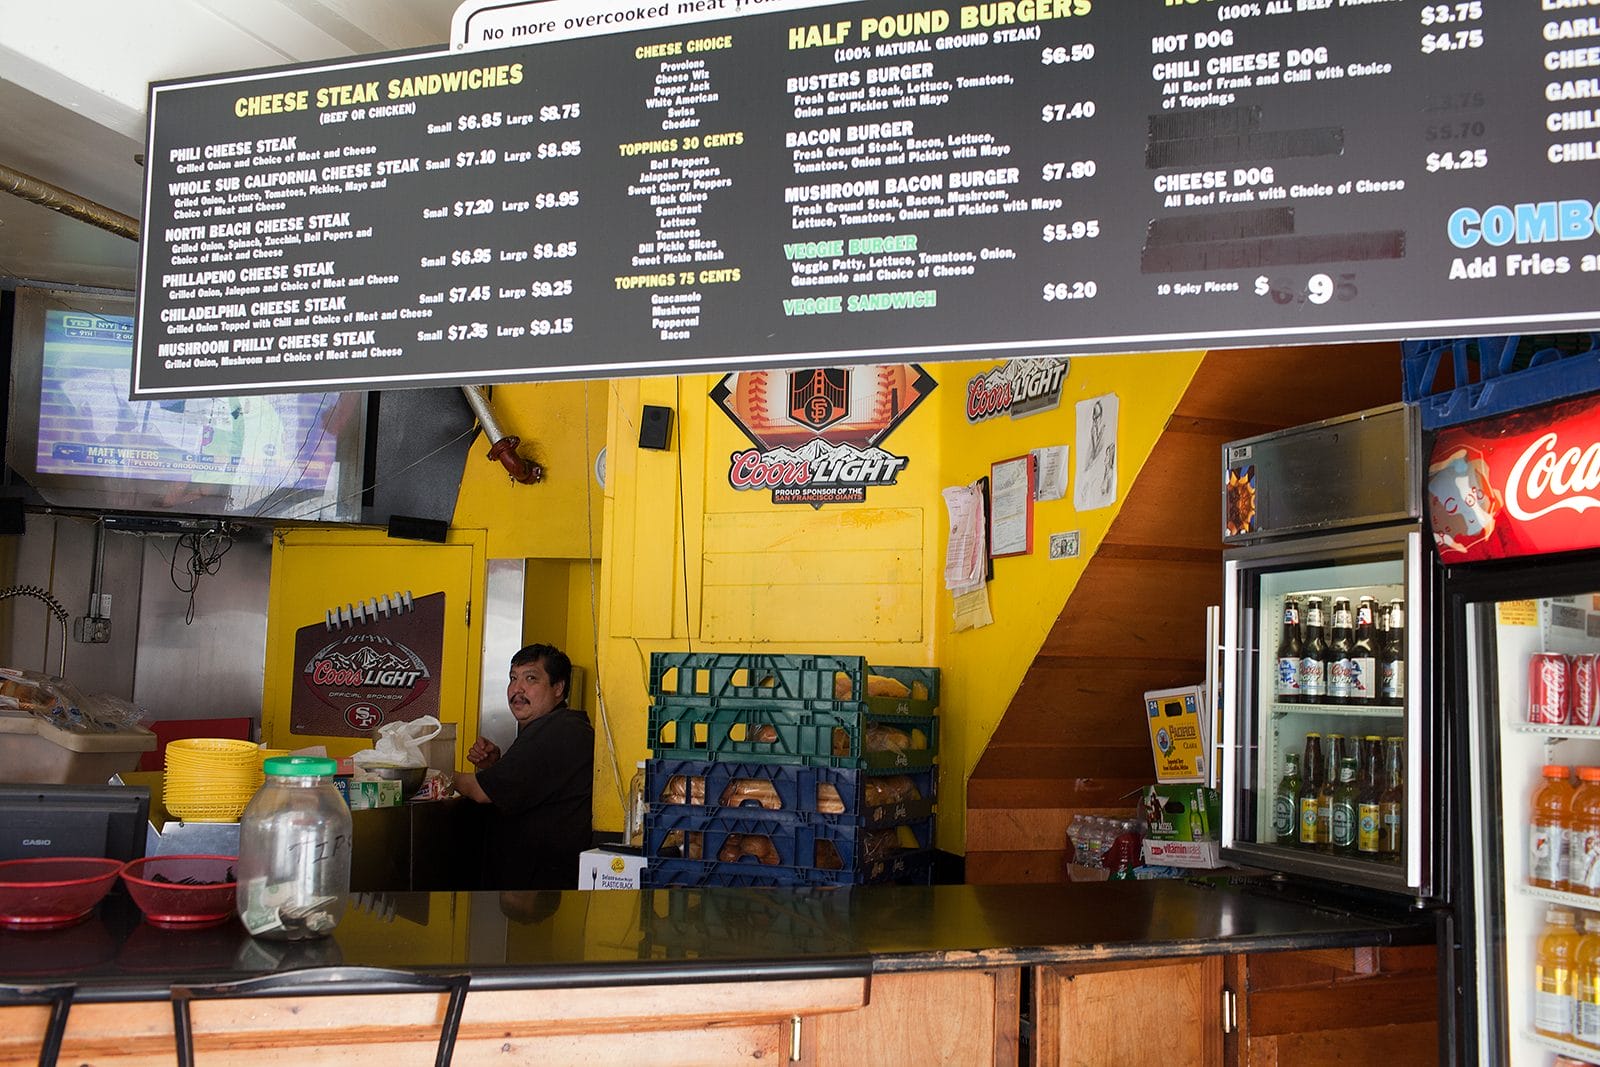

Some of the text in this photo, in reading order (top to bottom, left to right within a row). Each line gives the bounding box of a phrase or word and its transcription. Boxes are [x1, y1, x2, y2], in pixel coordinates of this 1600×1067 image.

[483, 28, 504, 41] No
[511, 21, 556, 37] more
[564, 6, 669, 30] overcooked
[677, 0, 726, 15] meat
[1217, 3, 1261, 21] (100%
[1266, 0, 1292, 14] ALL
[789, 0, 1091, 50] HALF POUND BURGERS
[635, 36, 732, 59] CHEESE CHOICE
[834, 25, 1041, 63] (100% NATURAL GROUND STEAK)
[1041, 43, 1095, 65] $6.50
[1152, 29, 1233, 54] HOT DOG
[660, 59, 705, 73] Provolone
[1152, 46, 1327, 80] CHILI CHEESE DOG
[655, 68, 709, 85] Cheese Wiz
[787, 62, 933, 93] BUSTERS BURGER
[235, 63, 523, 117] CHEESE STEAK SANDWICHES
[645, 92, 718, 109] White American
[1162, 92, 1235, 109] of Toppings
[427, 102, 580, 134] Small $6.85 Large $8.75
[1041, 100, 1095, 123] $7.40
[619, 132, 743, 156] TOPPINGS 30 CENTS
[786, 120, 913, 147] BACON BURGER
[169, 136, 297, 162] PHILI CHEESE STEAK
[1426, 148, 1488, 173] $4.25
[168, 157, 419, 196] WHOLE SUB CALIFORNIA CHEESE STEAK
[1042, 160, 1096, 182] $7.80
[1154, 166, 1273, 192] CHEESE DOG
[784, 167, 1019, 203] MUSHROOM BACON BURGER
[655, 203, 702, 217] Saurkraut
[165, 212, 350, 242] NORTH BEACH CHEESE STEAK
[1447, 199, 1600, 249] COMB
[631, 249, 724, 266] Sweet Pickle Relish
[783, 235, 917, 259] VEGGIE BURGER
[162, 261, 334, 287] PHILLAPENO CHEESE STEAK
[791, 264, 975, 287] Guacamole and Choice of Cheese
[1448, 255, 1497, 280] Add
[1506, 252, 1571, 276] Fries
[614, 268, 740, 290] TOPPINGS 75 CENTS
[1157, 281, 1239, 296] 10 Spicy Pieces
[160, 295, 346, 322] CHILADELPHIA CHEESE STEAK
[782, 290, 936, 315] VEGGIE SANDWICH
[652, 315, 699, 330] Pepperoni
[158, 330, 375, 357] MUSHROOM PHILLY CHEESE STEAK
[968, 379, 1012, 417] Coors
[1013, 363, 1066, 403] LIGHT
[88, 446, 159, 460] MATT WIETERS
[731, 451, 904, 486] Coors LIGHT
[313, 660, 421, 687] Coors LIGHT
[355, 706, 377, 727] SF
